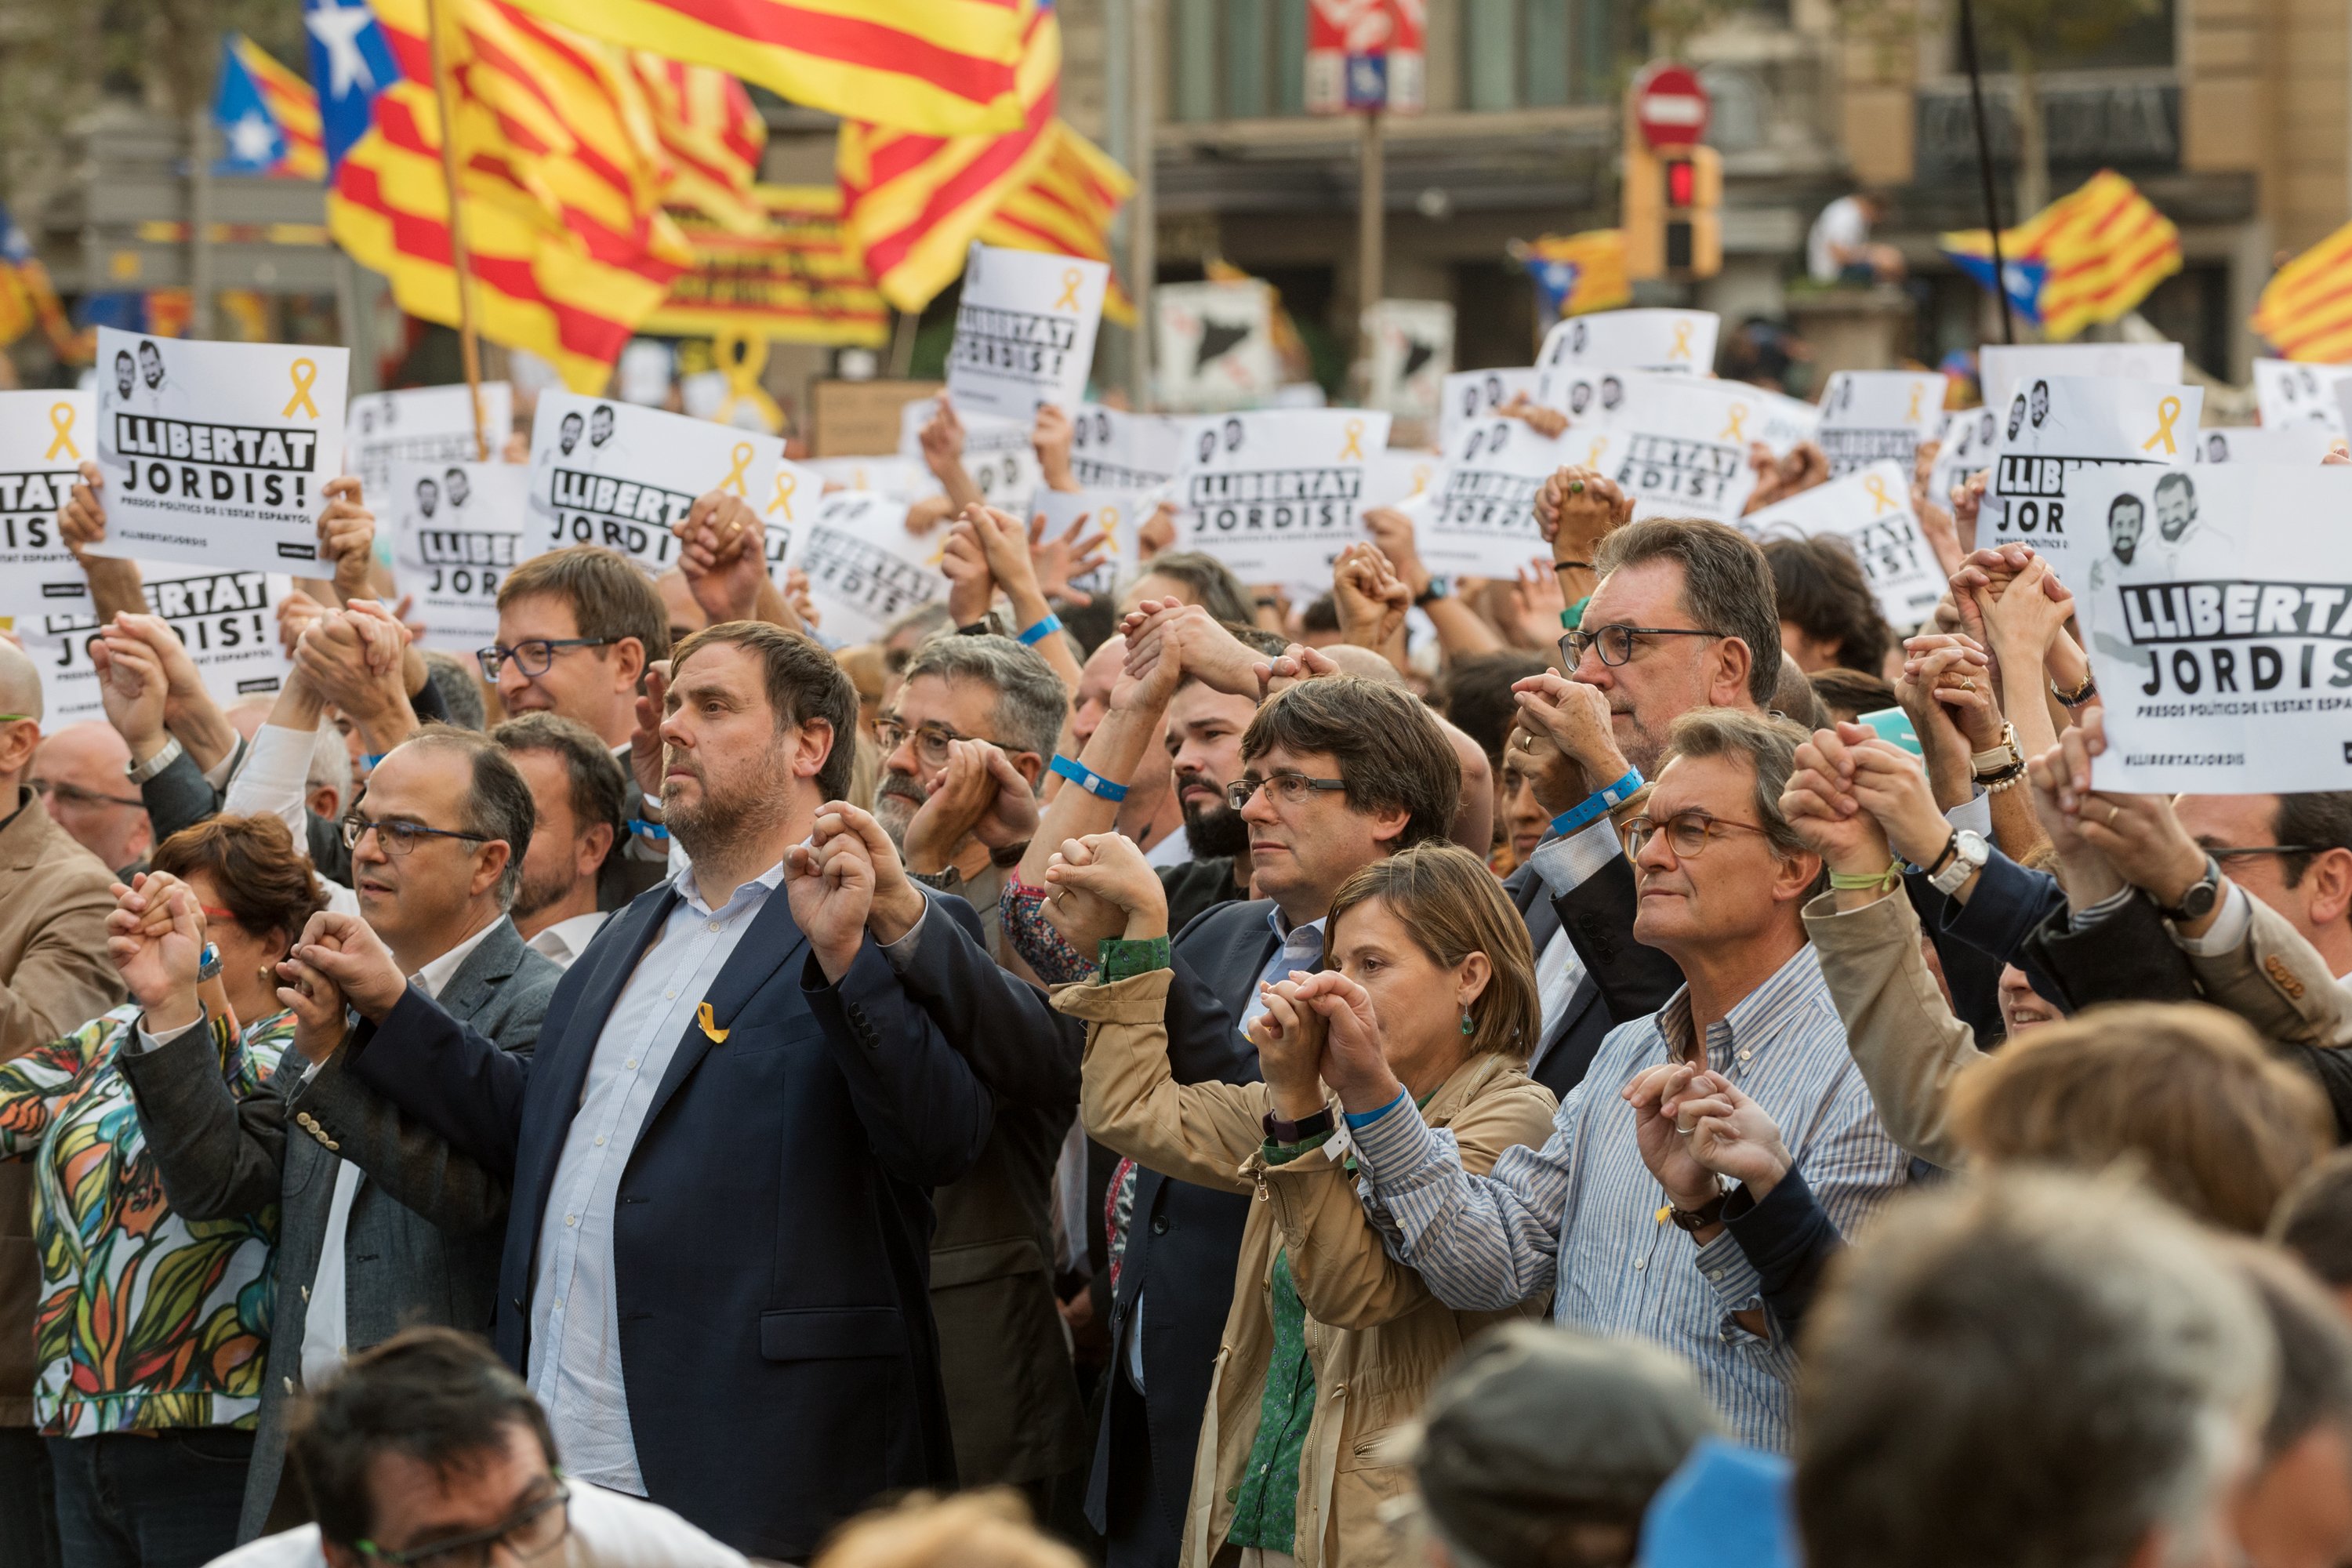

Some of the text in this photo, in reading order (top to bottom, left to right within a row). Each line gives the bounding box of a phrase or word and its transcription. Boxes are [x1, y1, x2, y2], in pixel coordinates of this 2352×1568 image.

[117, 414, 315, 470] LLIBERTAT
[122, 459, 306, 508] JORDIS!
[1193, 504, 1353, 532] JORDIS!
[2136, 704, 2186, 718] PRESOS
